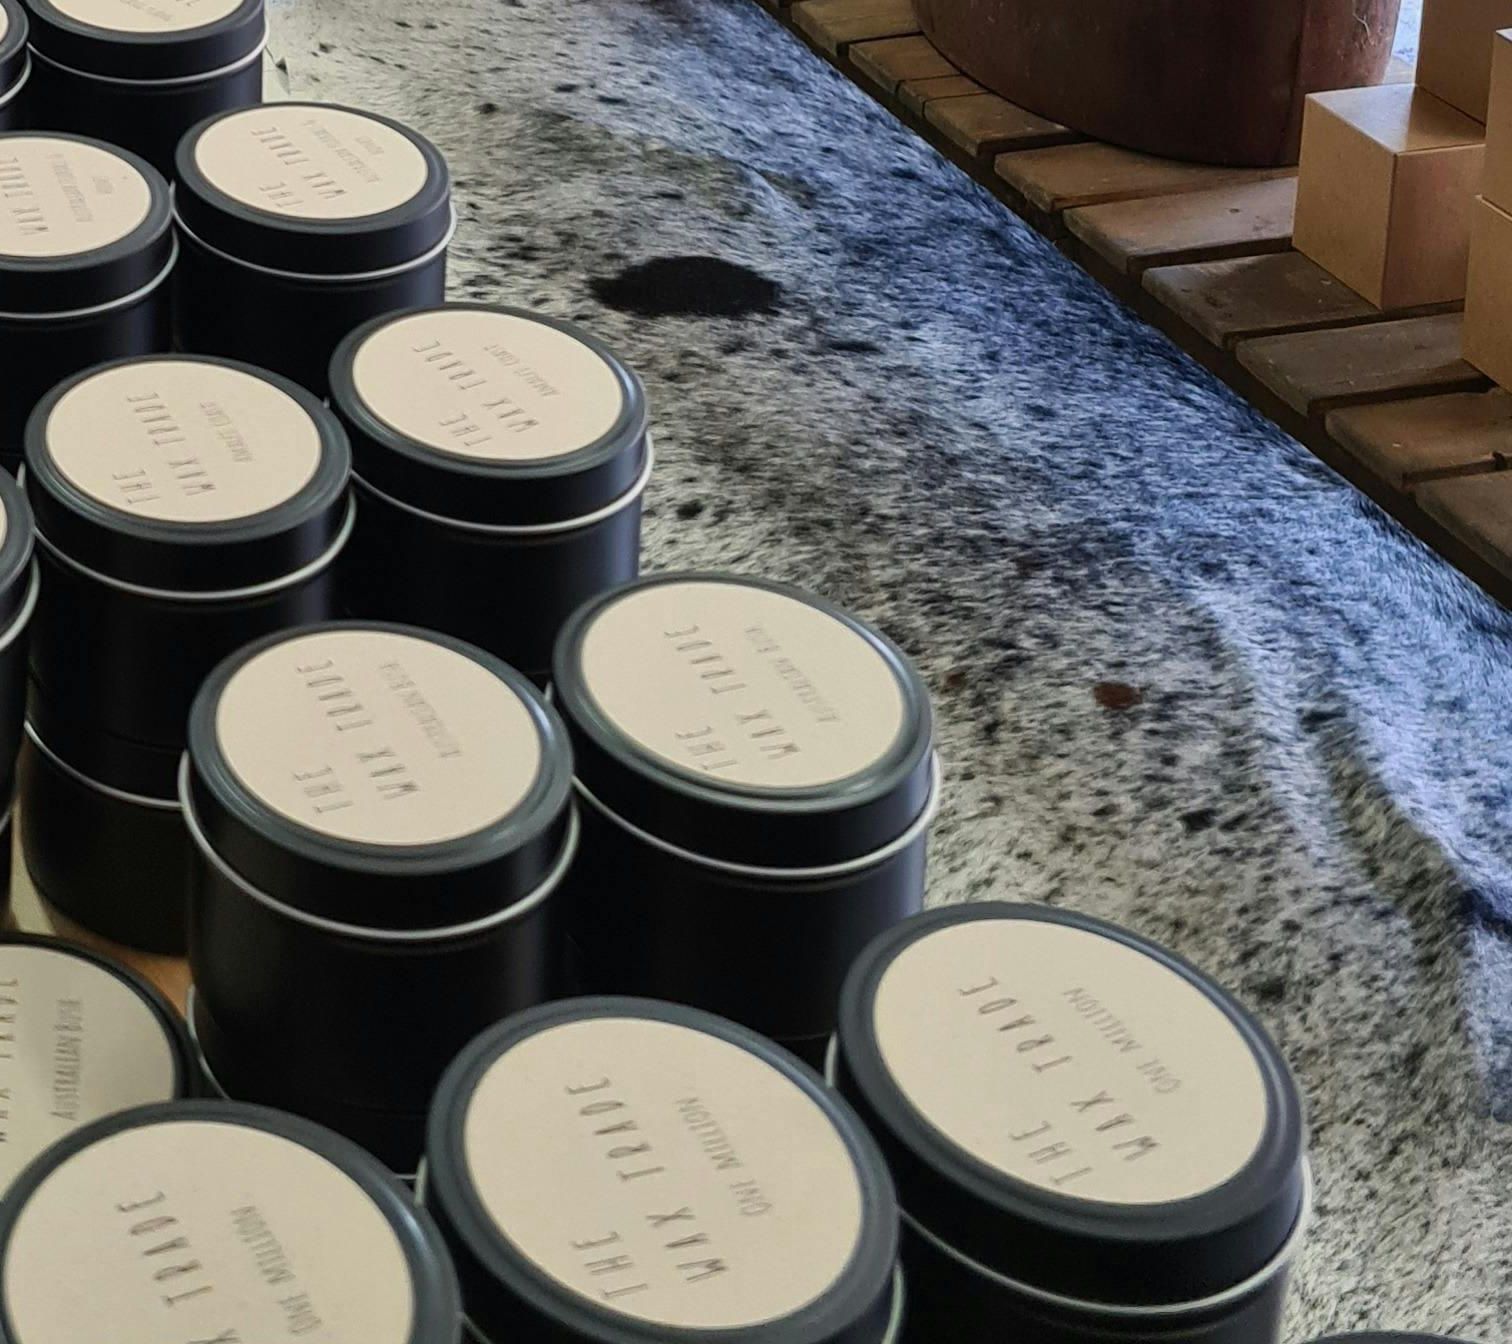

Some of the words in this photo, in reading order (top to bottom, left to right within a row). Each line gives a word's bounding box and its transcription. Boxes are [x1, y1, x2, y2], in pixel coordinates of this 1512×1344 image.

[664, 625, 748, 695] TRADE
[296, 659, 374, 732] TRADE
[674, 726, 738, 771] THE
[735, 708, 801, 761] WAX
[293, 766, 355, 814] THE
[356, 744, 424, 800] WAX
[957, 975, 1075, 1073] TRADE
[1061, 986, 1143, 1053] MILLION
[1136, 1058, 1183, 1094] ONE
[564, 1076, 668, 1183] TRADE
[673, 1095, 745, 1174] MILLION
[1011, 1119, 1094, 1187] THE
[1068, 1088, 1162, 1162] WAX
[113, 1190, 215, 1308] TRADE
[570, 1231, 649, 1299] THE
[644, 1206, 728, 1285] WAX
